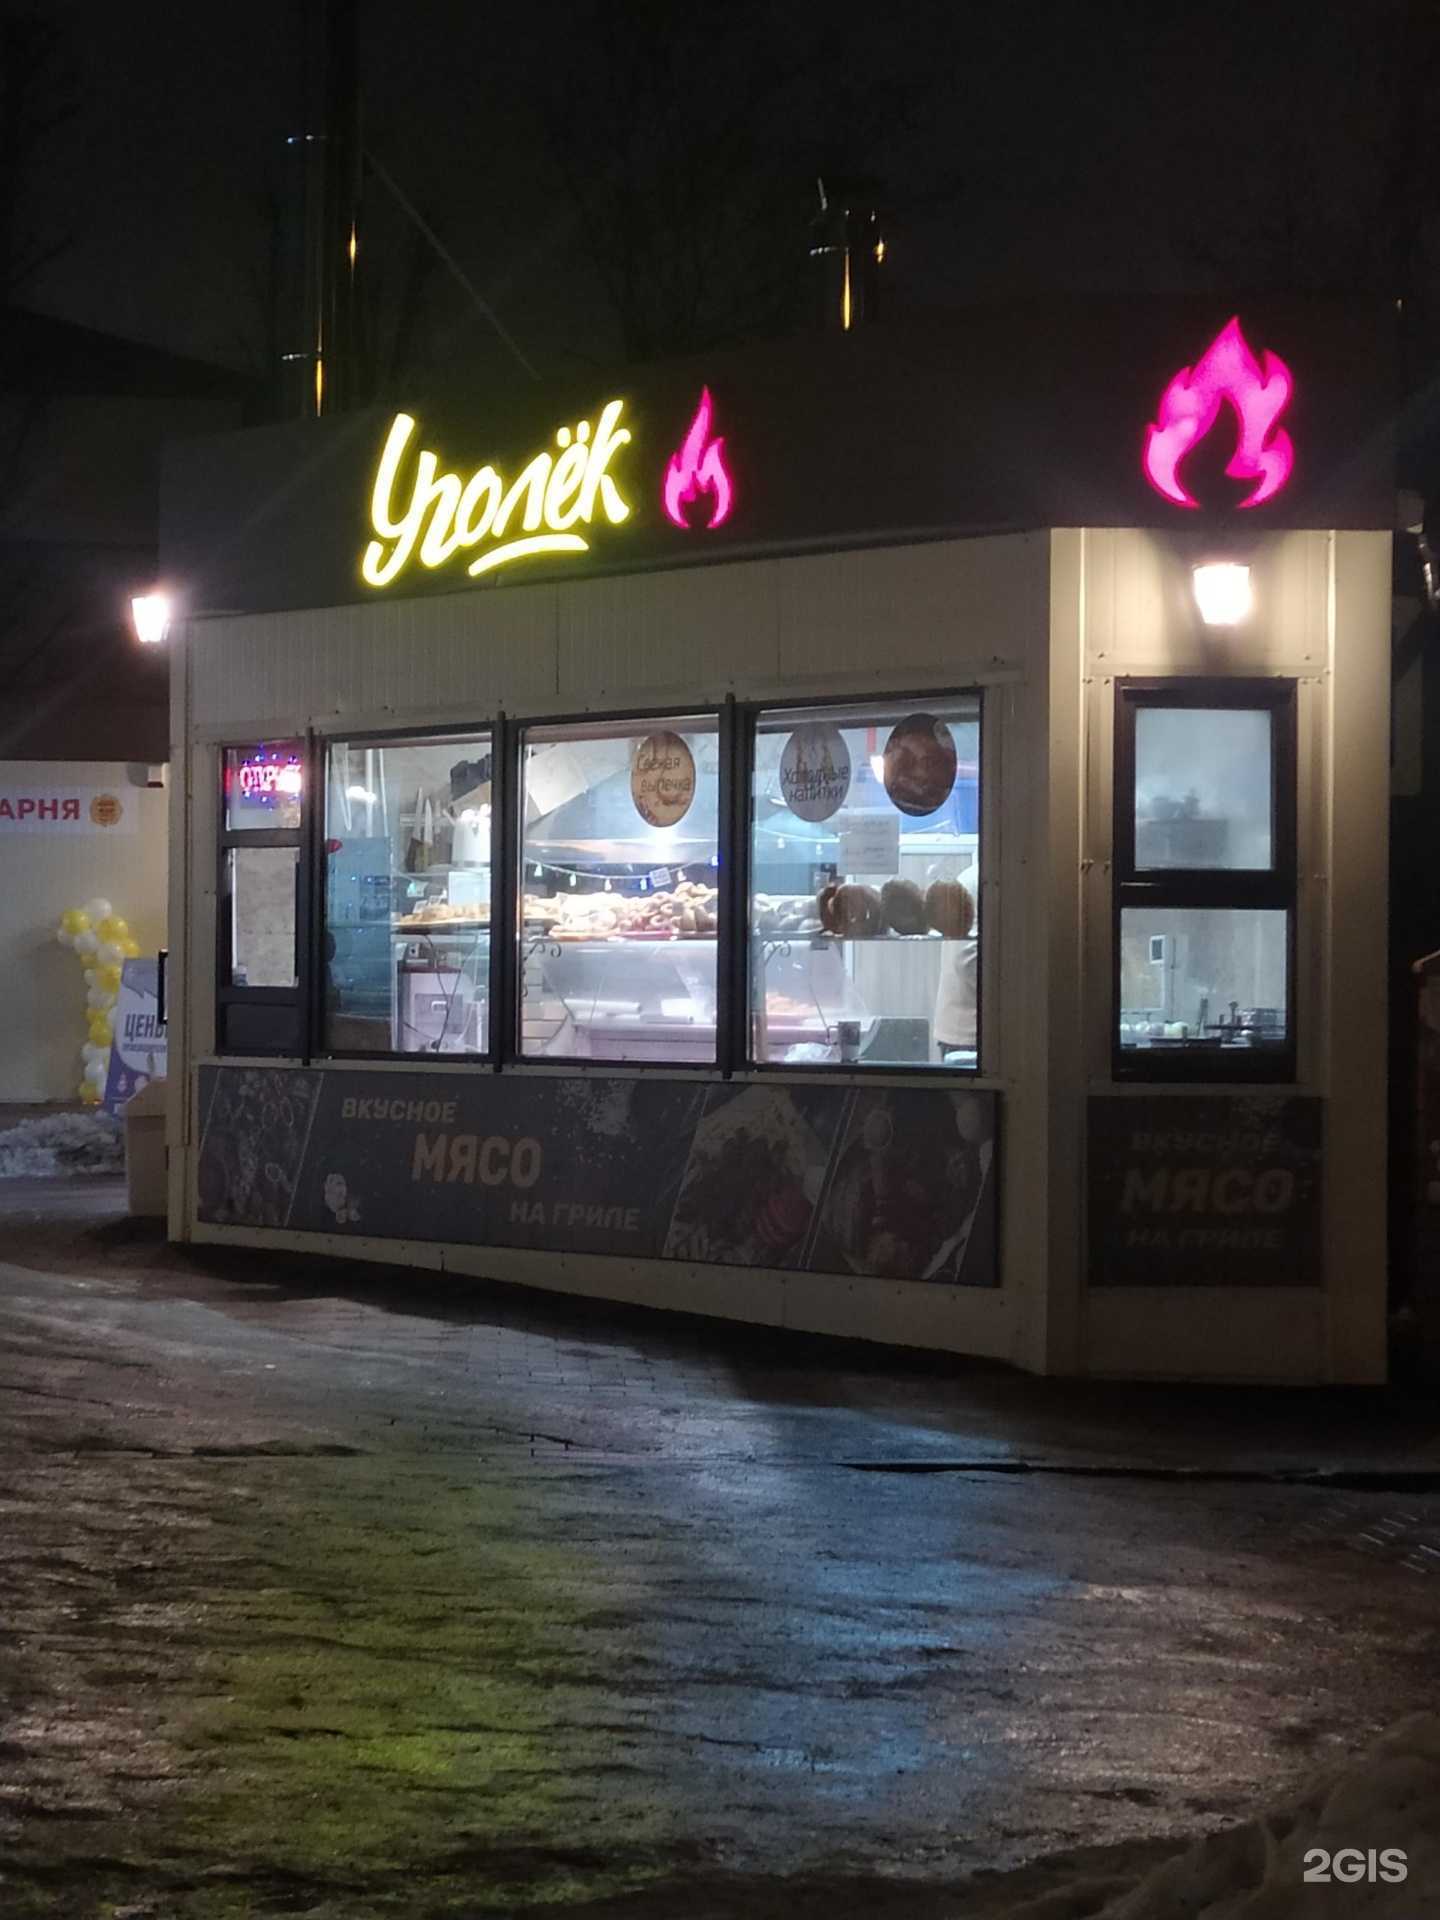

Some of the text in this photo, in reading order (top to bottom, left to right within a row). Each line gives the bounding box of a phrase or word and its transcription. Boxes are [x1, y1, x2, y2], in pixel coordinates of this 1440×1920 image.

[361, 399, 632, 587] Уголёк
[342, 1098, 457, 1123] ВКУСНОЕ
[411, 1133, 542, 1189] МЯСО
[1120, 1168, 1297, 1215] МЯСО
[509, 1201, 641, 1231] НА ГРИЛЕ
